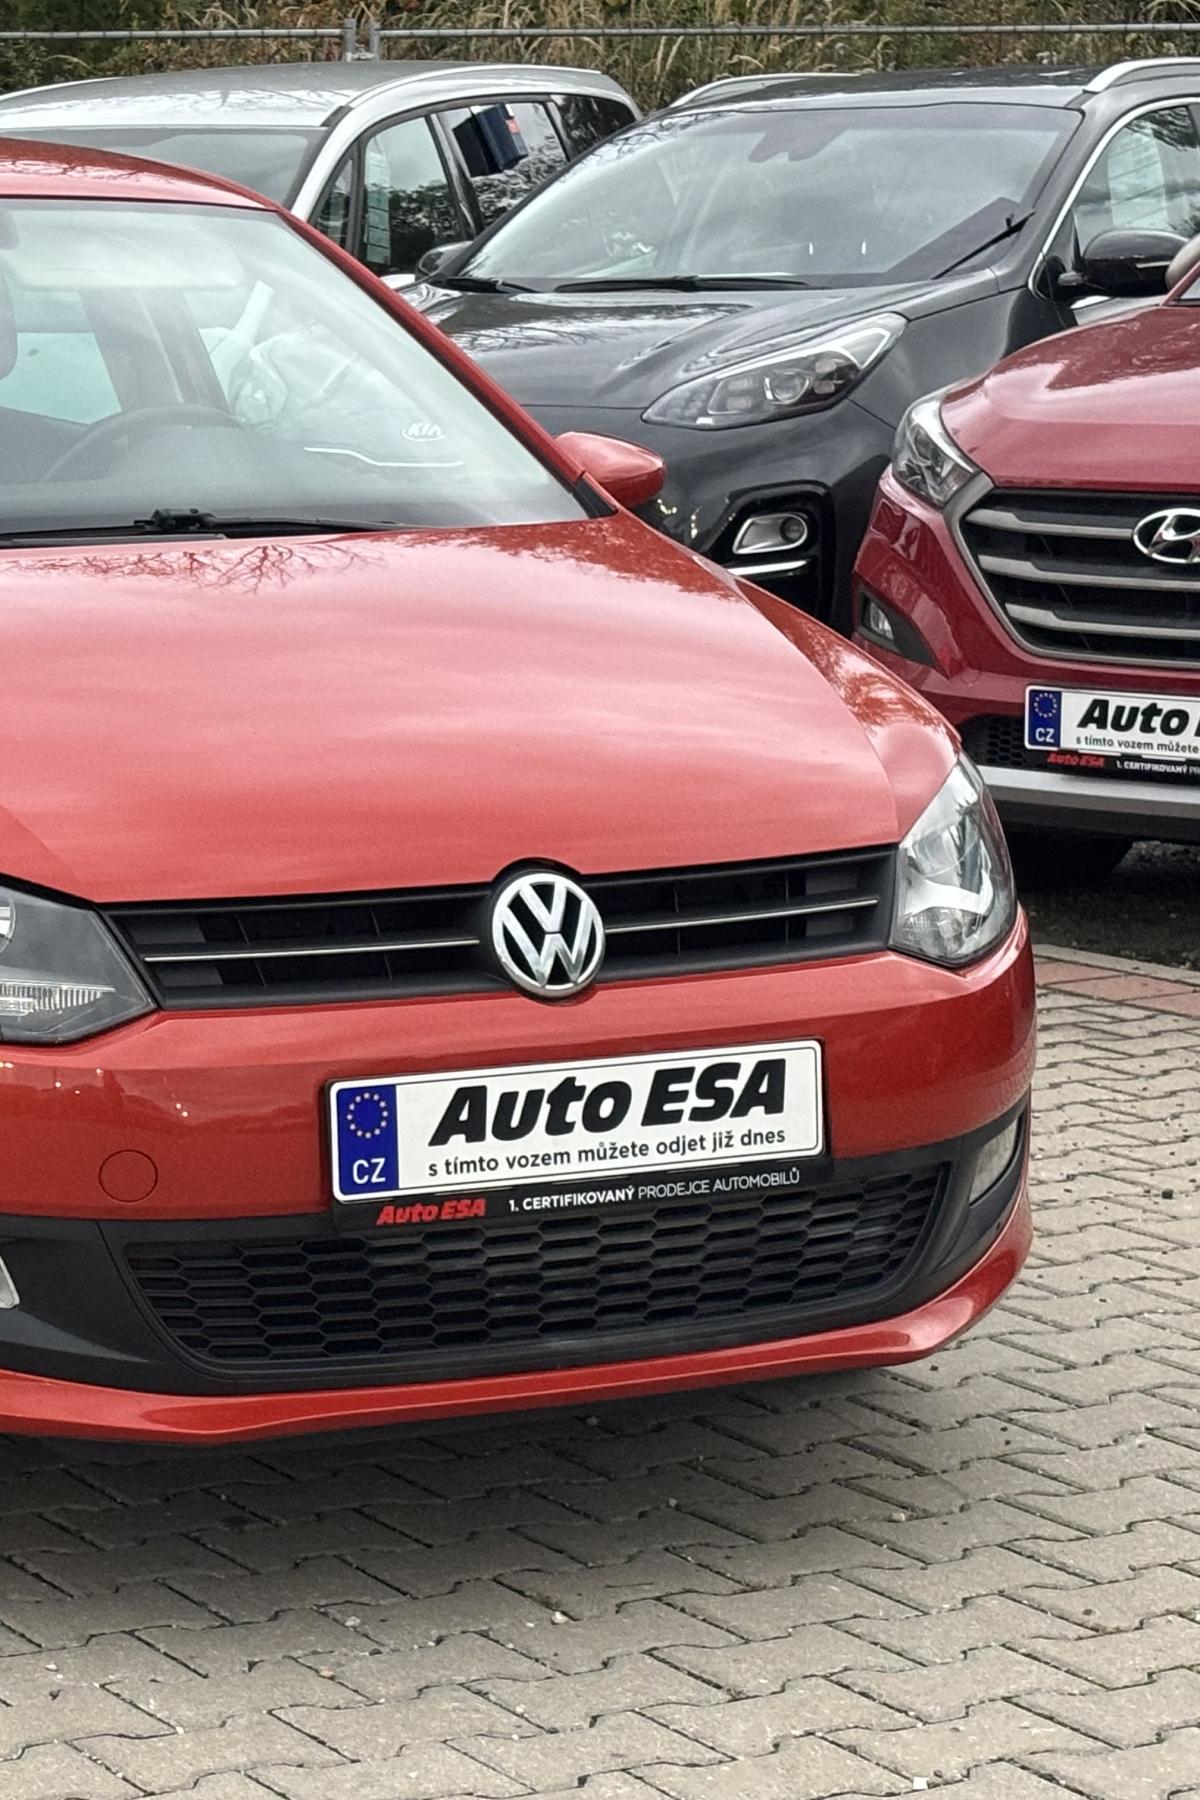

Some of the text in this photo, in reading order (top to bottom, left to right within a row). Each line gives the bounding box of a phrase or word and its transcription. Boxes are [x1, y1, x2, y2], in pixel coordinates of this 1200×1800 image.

[407, 422, 443, 436] KIA
[1076, 698, 1190, 737] Auto
[1035, 727, 1055, 743] CZ
[1075, 734, 1199, 754] s tímto vozem můžete
[427, 1058, 786, 1147] Auto ESA
[428, 1128, 786, 1177] s tímto vozem můžete odjet již dnes
[352, 1157, 386, 1184] CZ
[508, 1166, 800, 1213] 1. CERTIFIKOVANÝ PRODEJCE AUTOMOBILŮ
[376, 1198, 487, 1226] Auto ESA
